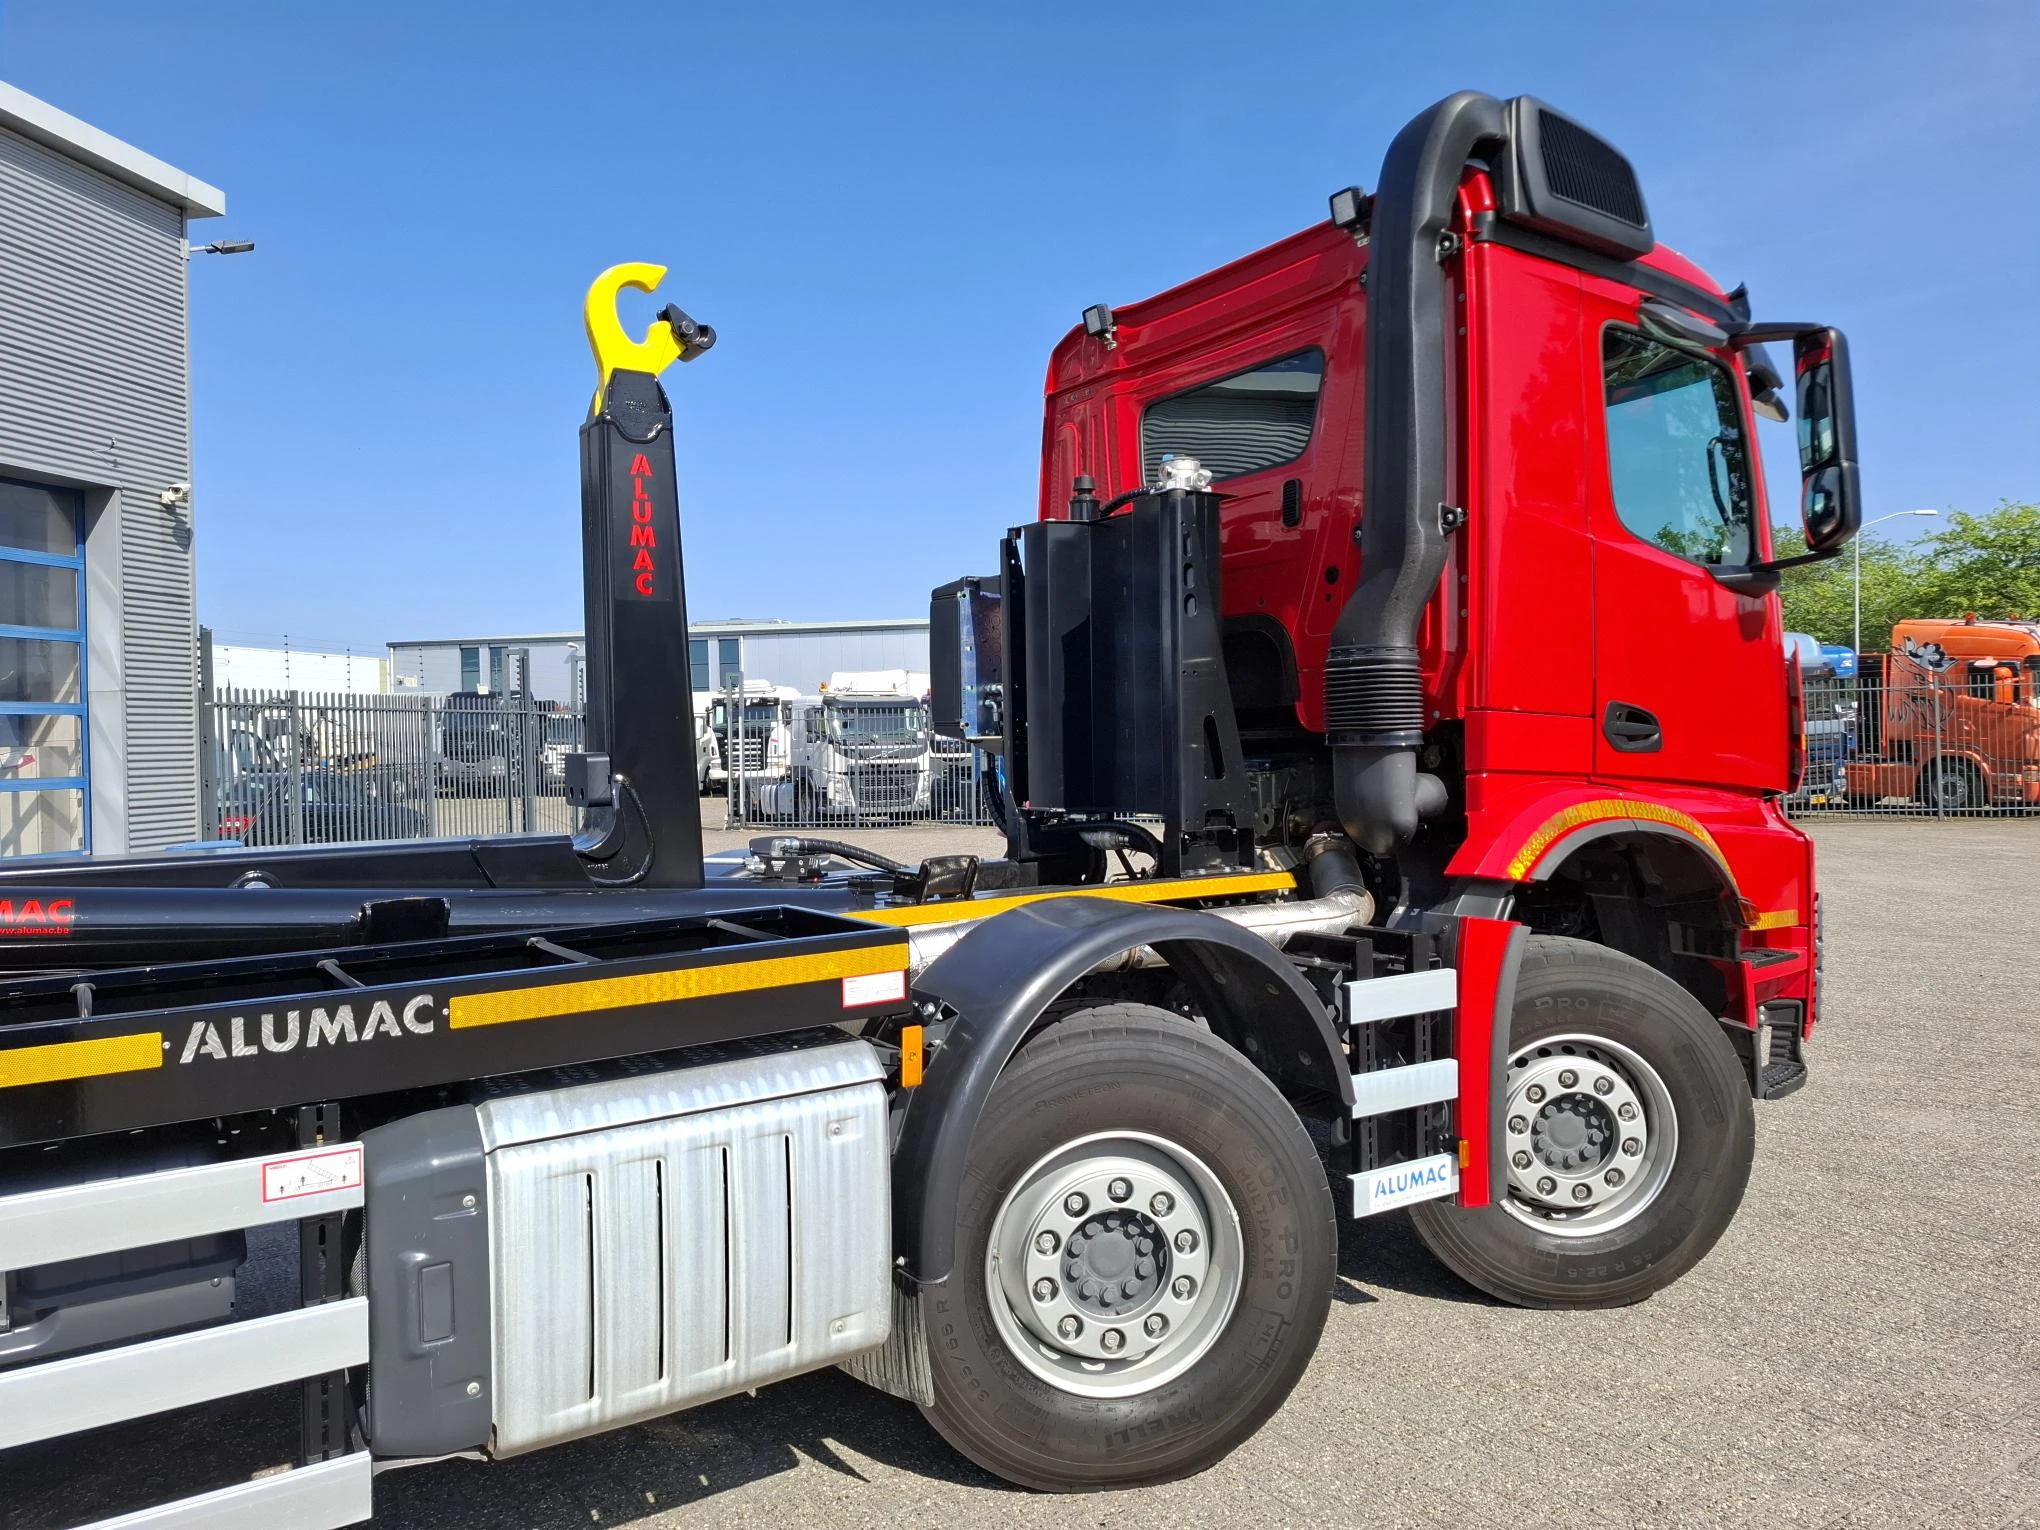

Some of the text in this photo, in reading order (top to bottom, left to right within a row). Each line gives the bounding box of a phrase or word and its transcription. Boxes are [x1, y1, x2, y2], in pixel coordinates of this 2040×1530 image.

[630, 453, 656, 595] ALUMAC
[179, 994, 434, 1064] ALUMAC
[1375, 1164, 1447, 1198] ALUMAC
[1236, 1167, 1274, 1280] MULTIAXLE
[1277, 1225, 1299, 1300] PRO
[942, 1323, 990, 1402] 385/65
